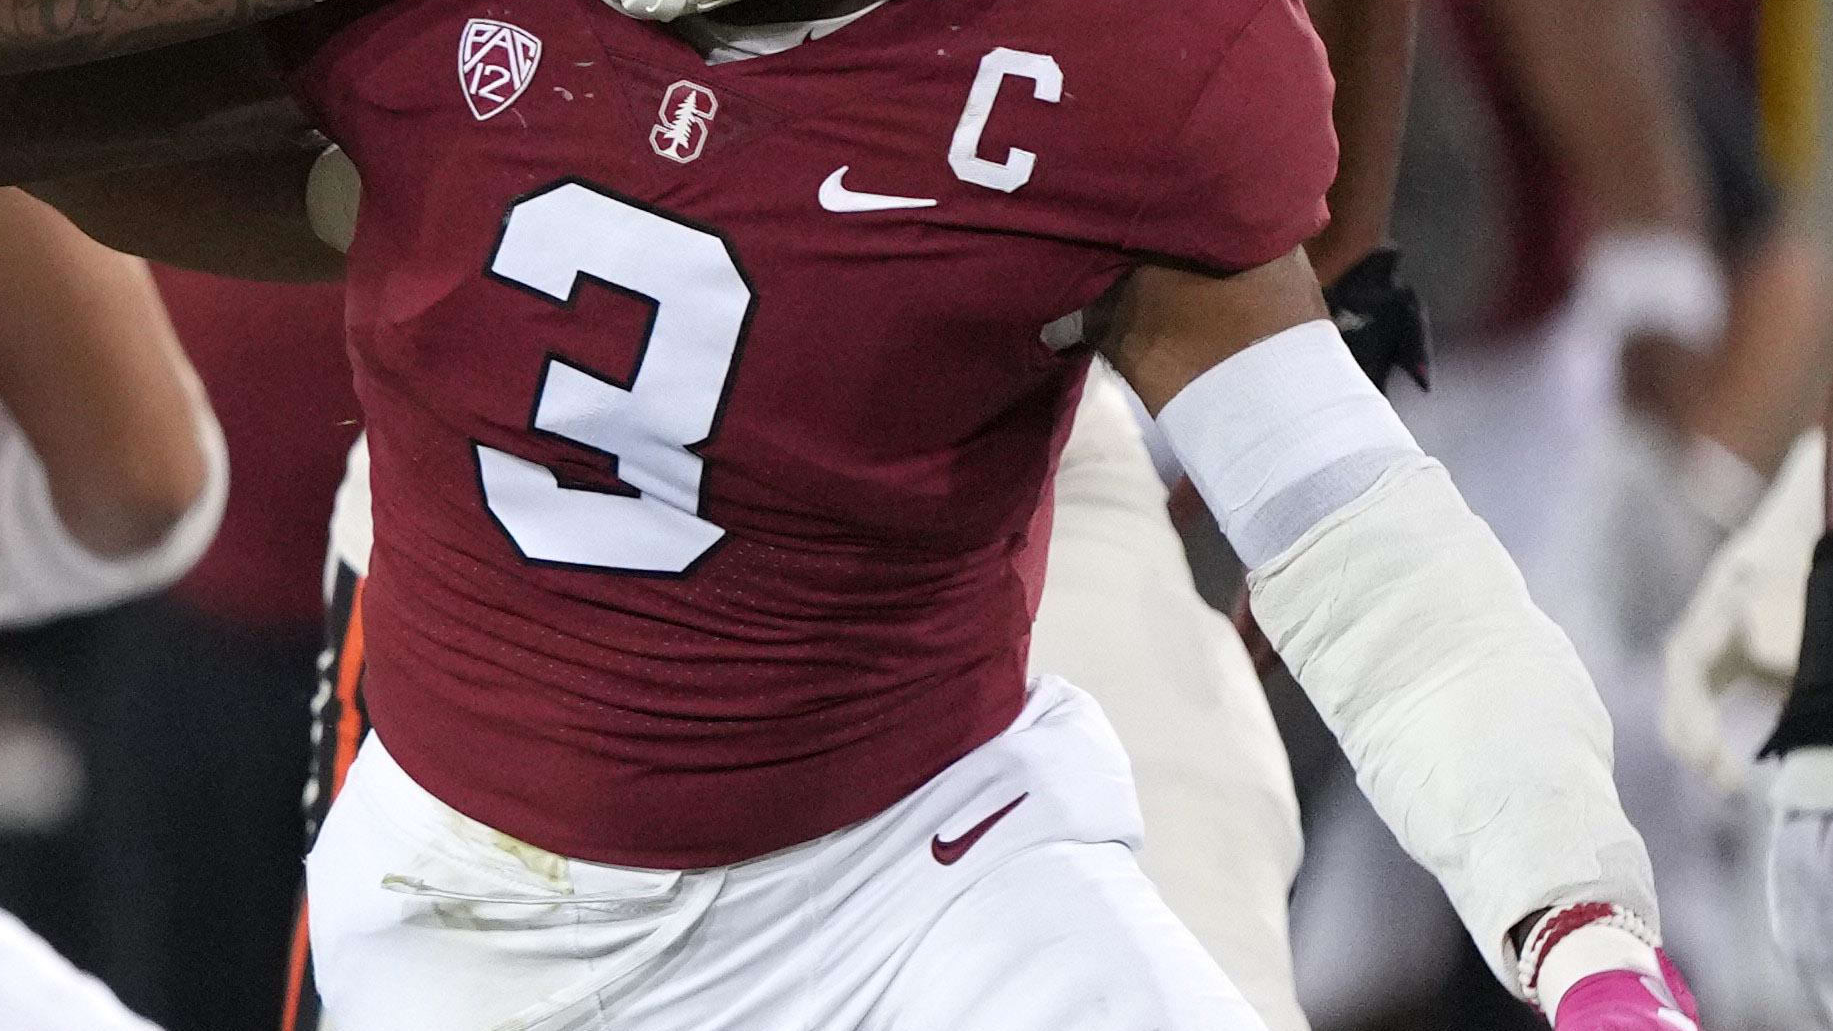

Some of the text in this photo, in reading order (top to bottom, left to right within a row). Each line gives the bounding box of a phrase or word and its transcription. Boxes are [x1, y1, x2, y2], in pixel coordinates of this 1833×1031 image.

[464, 23, 537, 91] PAC
[470, 62, 512, 103] 12
[948, 46, 1064, 194] C
[469, 174, 760, 581] 3
